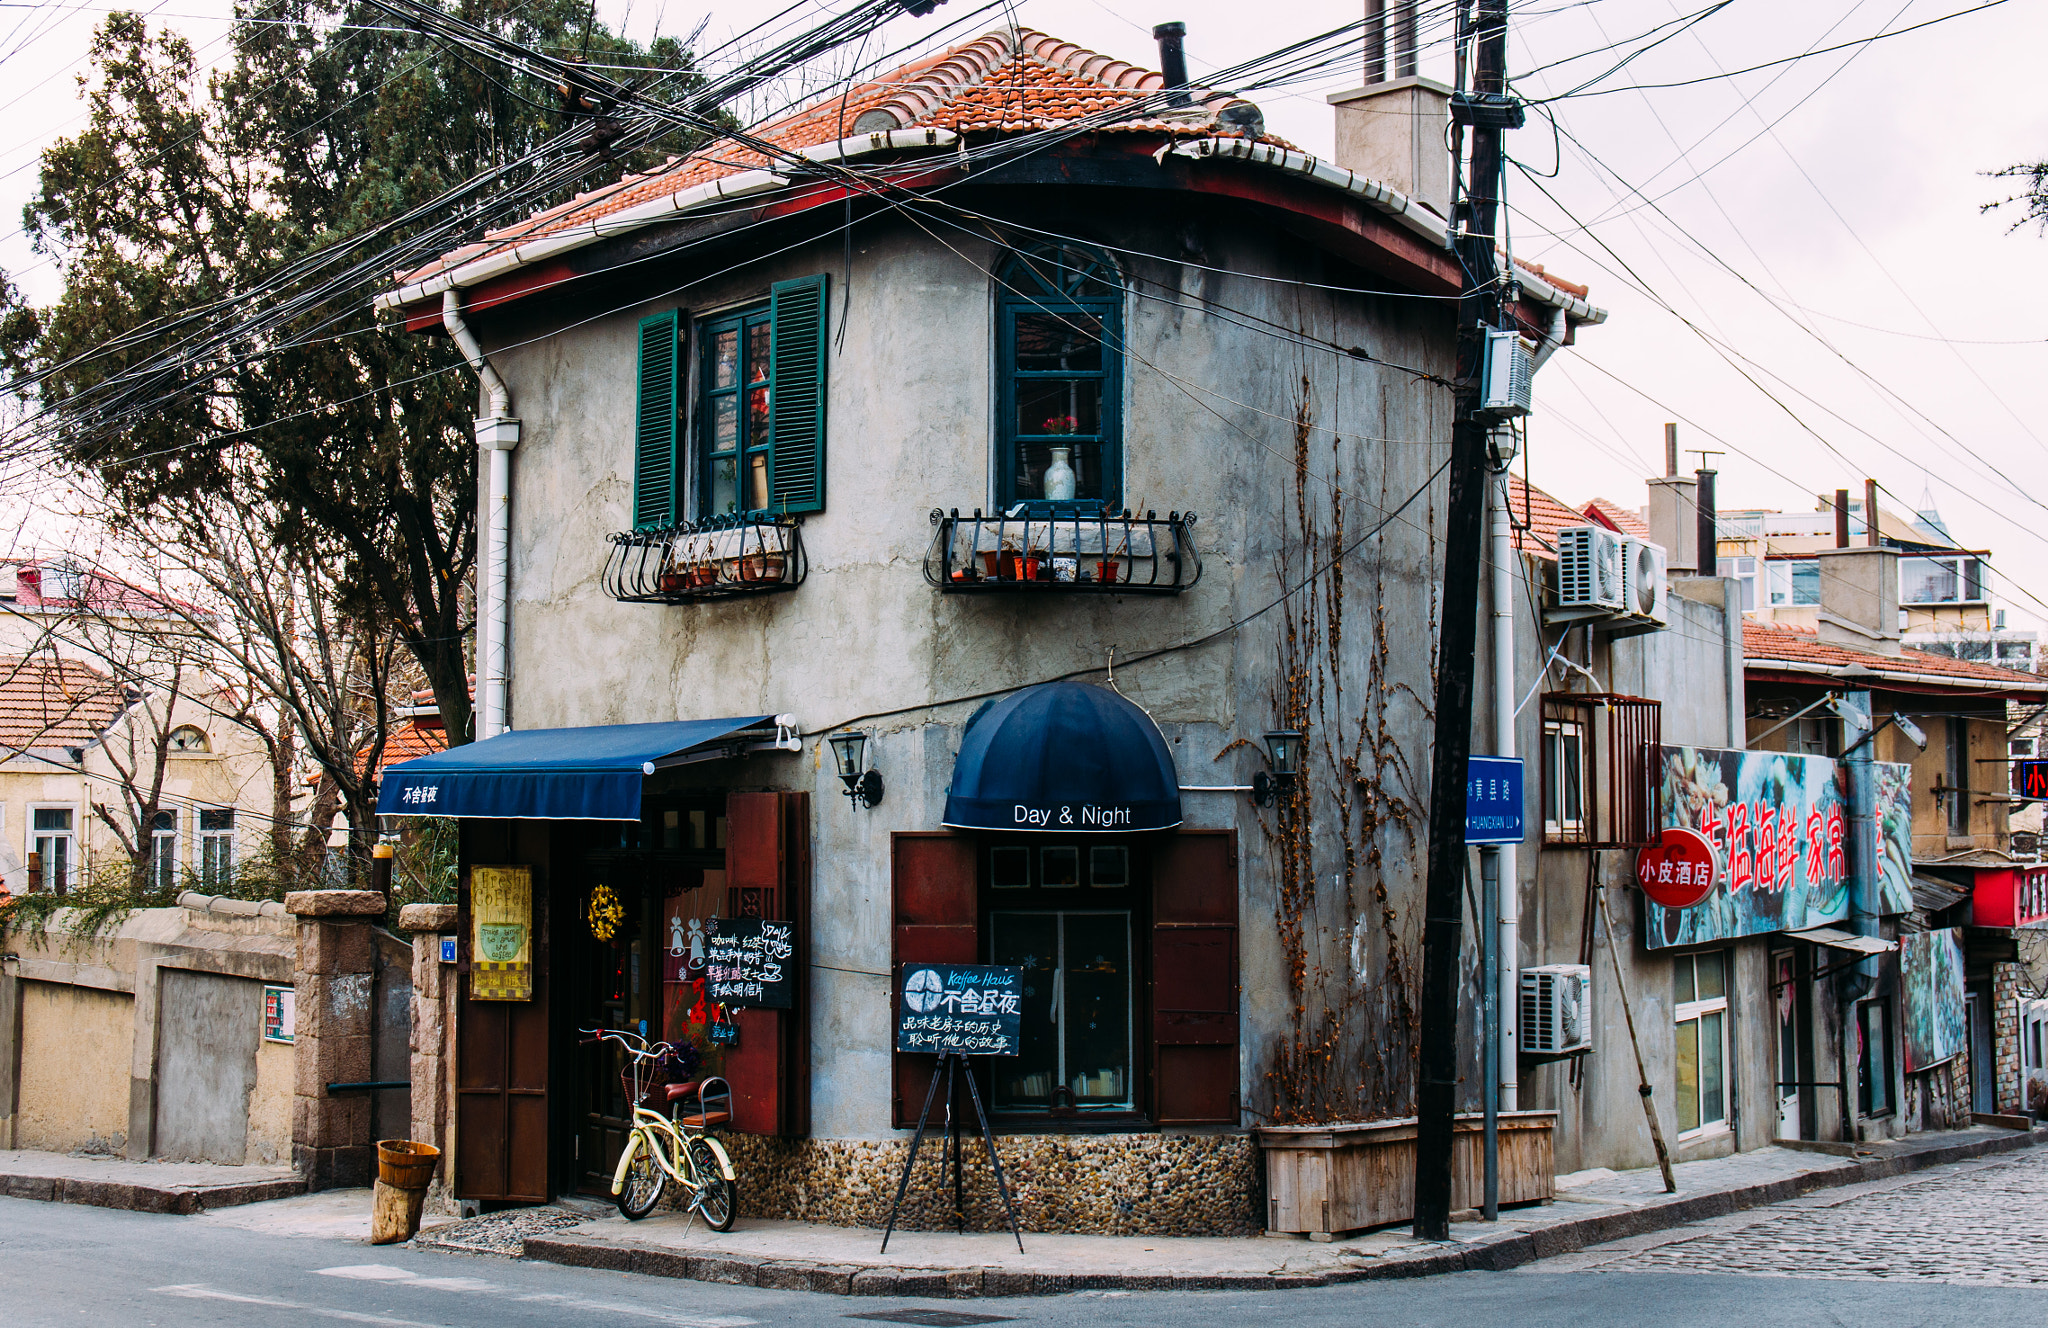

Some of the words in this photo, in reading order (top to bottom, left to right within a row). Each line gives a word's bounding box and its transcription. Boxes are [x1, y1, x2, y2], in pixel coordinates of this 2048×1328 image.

[2026, 764, 2048, 798] 小
[402, 785, 439, 805] 不舍昼夜
[1014, 804, 1051, 826] Day
[1059, 805, 1074, 824] &
[1082, 805, 1131, 827] Night
[1471, 816, 1504, 830] HUANGXIAN
[1506, 816, 1514, 829] LU
[1700, 798, 1800, 896] 生猛海鲜
[1806, 800, 1884, 888] 家常
[481, 871, 522, 890] Fresh
[1639, 858, 1710, 886] 小皮酒店
[711, 933, 740, 948] 咖啡
[742, 935, 764, 950] 红茶
[446, 949, 450, 959] 4
[708, 946, 743, 967] 单品手冲
[947, 970, 981, 990] Kaffee
[982, 972, 1015, 987] Haus
[710, 981, 764, 1002] 手绘明信片
[940, 987, 1021, 1015] 不舍昼夜
[712, 1025, 735, 1042] 营业中
[902, 1015, 1006, 1037] 品味老房子的历史
